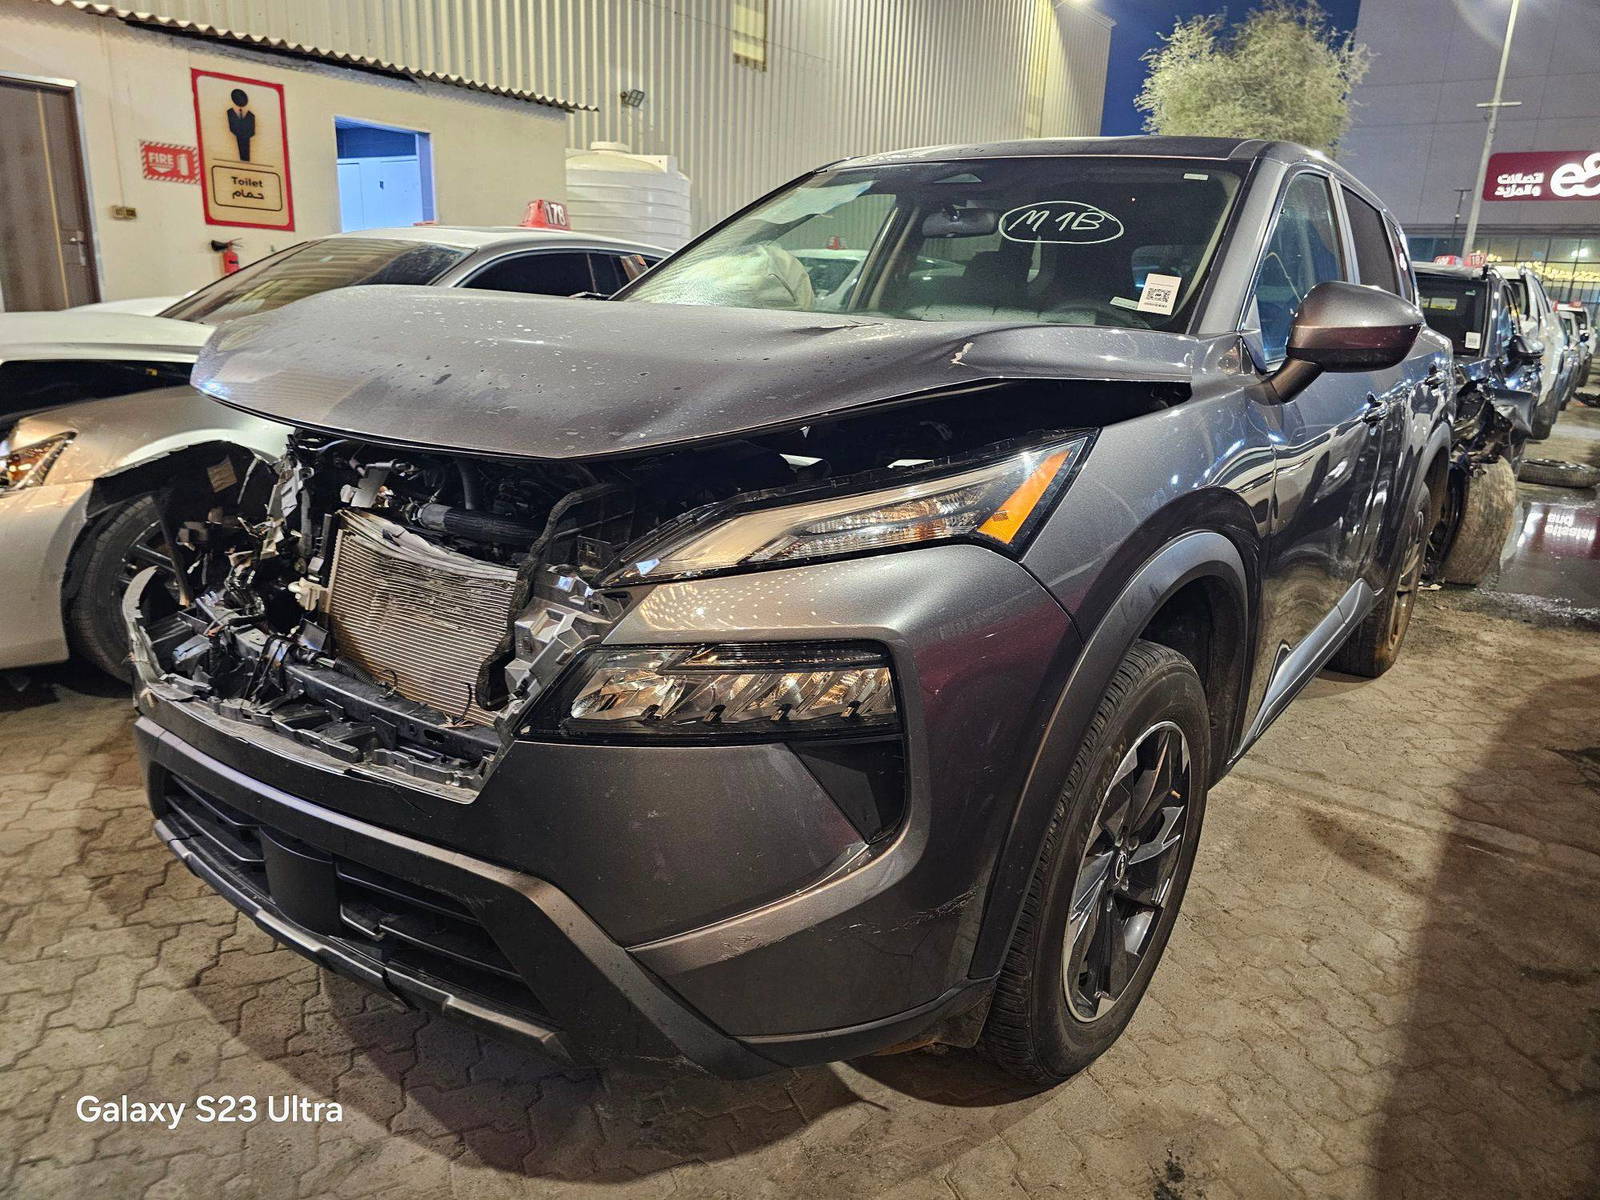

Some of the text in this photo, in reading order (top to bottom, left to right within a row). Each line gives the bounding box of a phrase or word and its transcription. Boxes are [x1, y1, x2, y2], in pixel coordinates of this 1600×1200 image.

[148, 152, 174, 165] FIRE
[231, 176, 263, 188] Toilet
[232, 189, 264, 200] حمام
[1008, 210, 1049, 232] M
